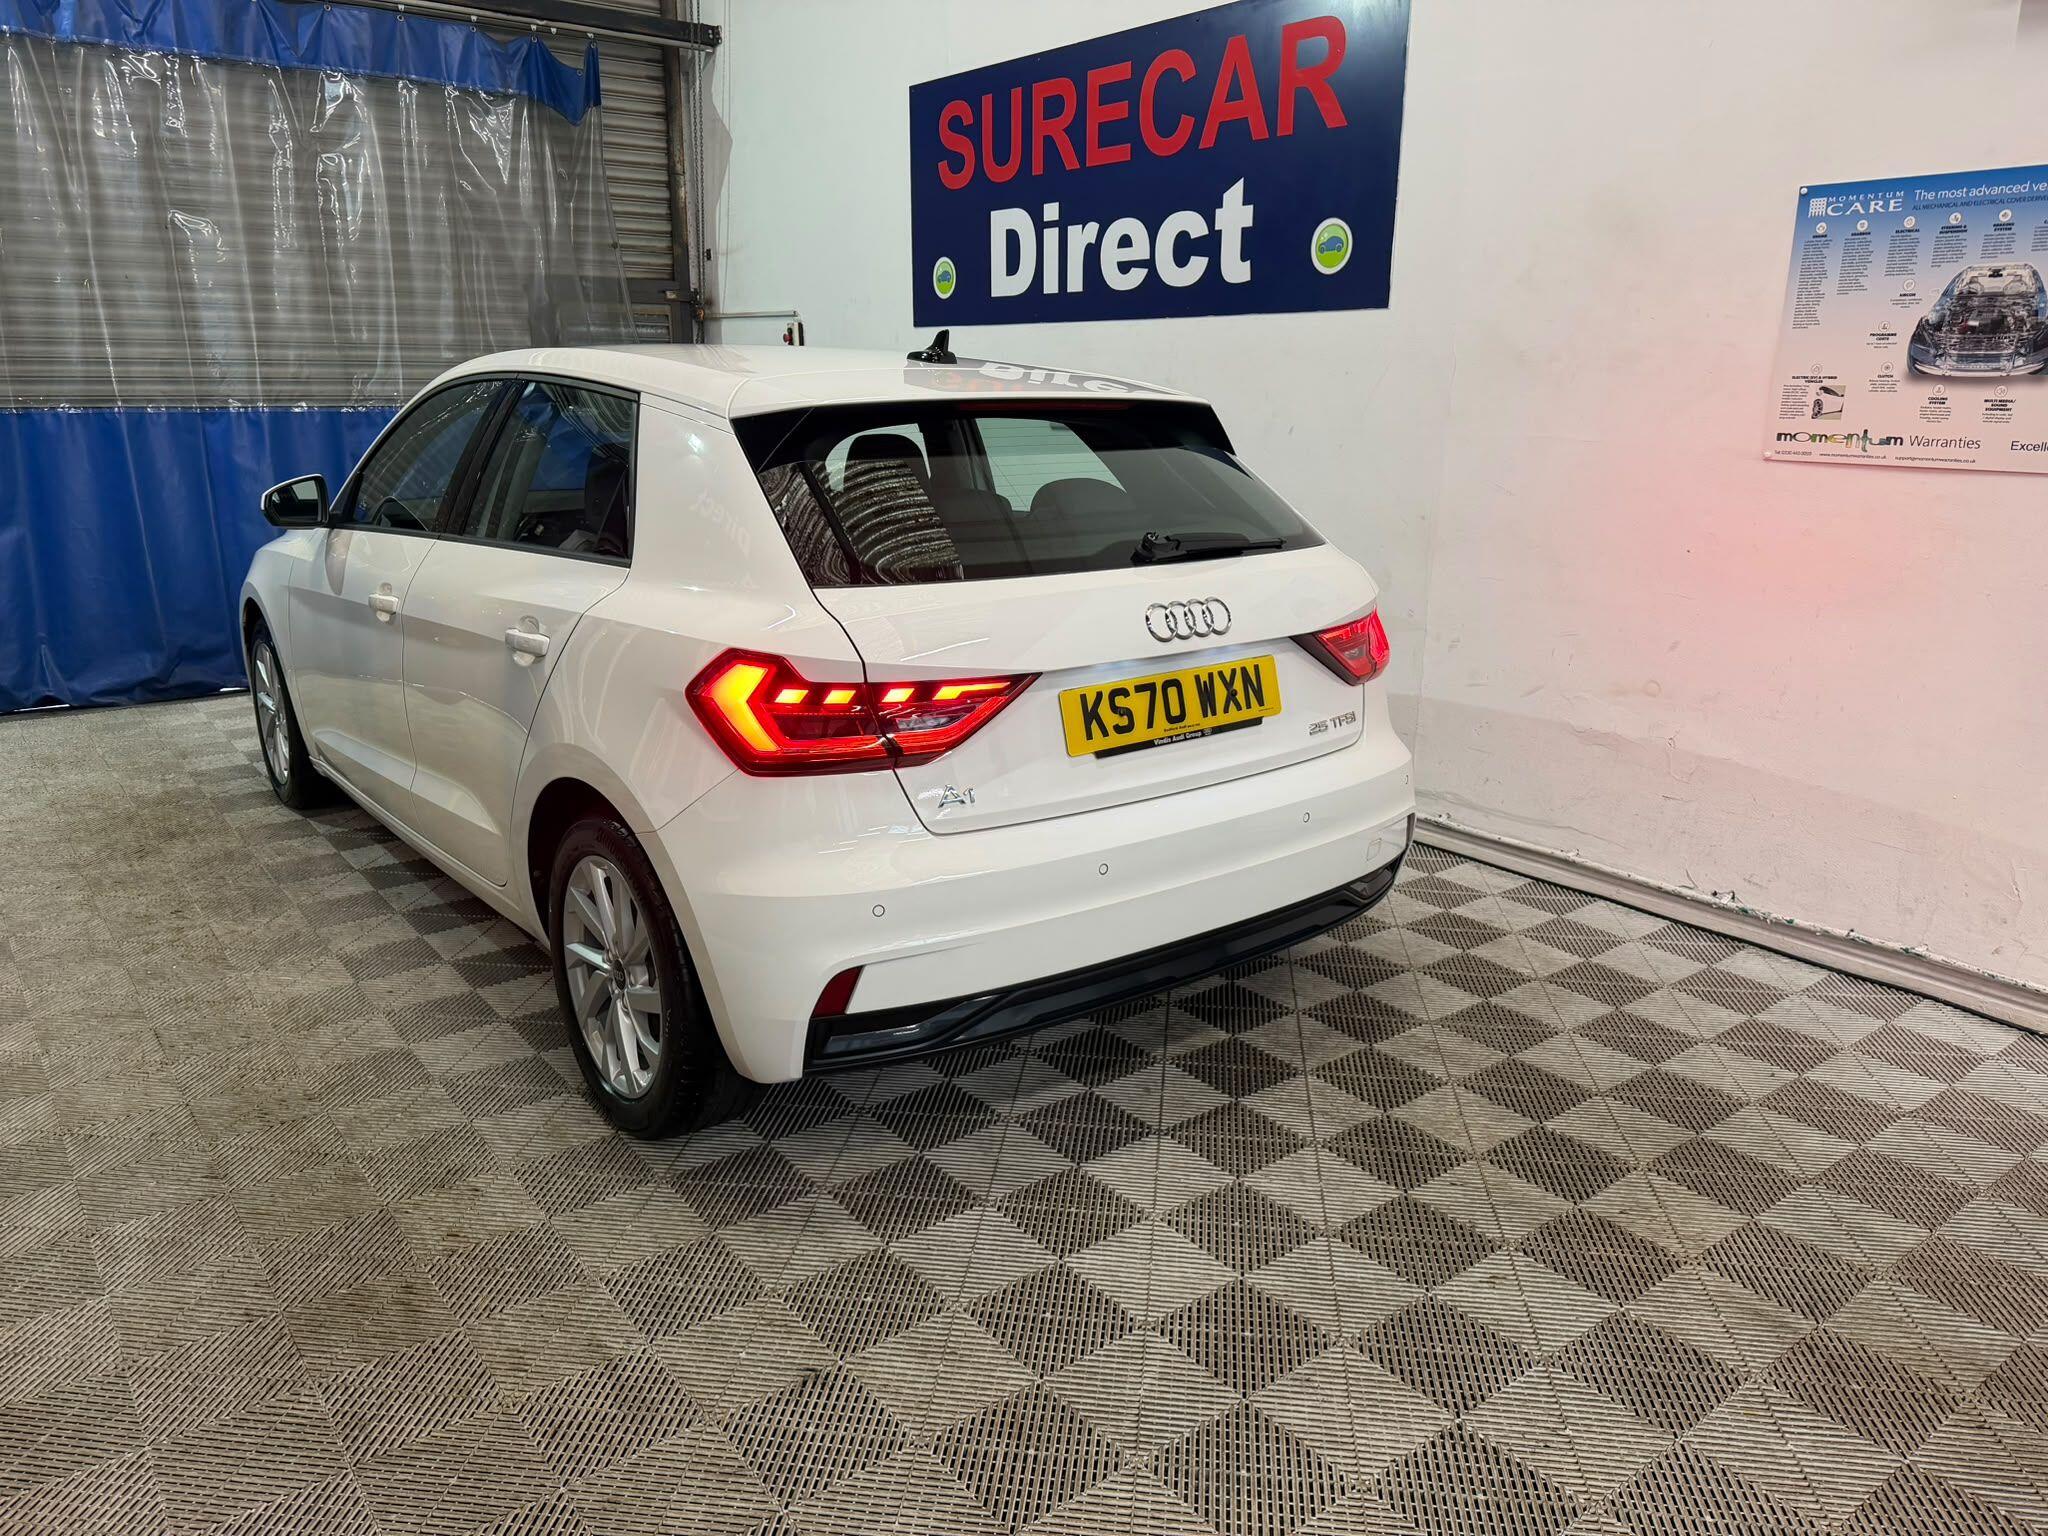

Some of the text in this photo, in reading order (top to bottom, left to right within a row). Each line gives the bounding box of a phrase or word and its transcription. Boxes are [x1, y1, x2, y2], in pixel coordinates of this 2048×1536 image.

[938, 15, 1348, 190] SURECAR
[1828, 190, 1905, 203] MOMENTUM
[1914, 180, 2048, 201] The most advanced ve
[1826, 198, 1903, 216] CARE
[990, 177, 1255, 298] Direct
[1776, 428, 2048, 453] momentum Warranties Excell
[1079, 663, 1265, 741] KS70 WXN
[1308, 710, 1357, 736] 25 TFSI
[1172, 732, 1185, 743] Audi
[1186, 730, 1203, 740] Group
[937, 784, 976, 809] A1
